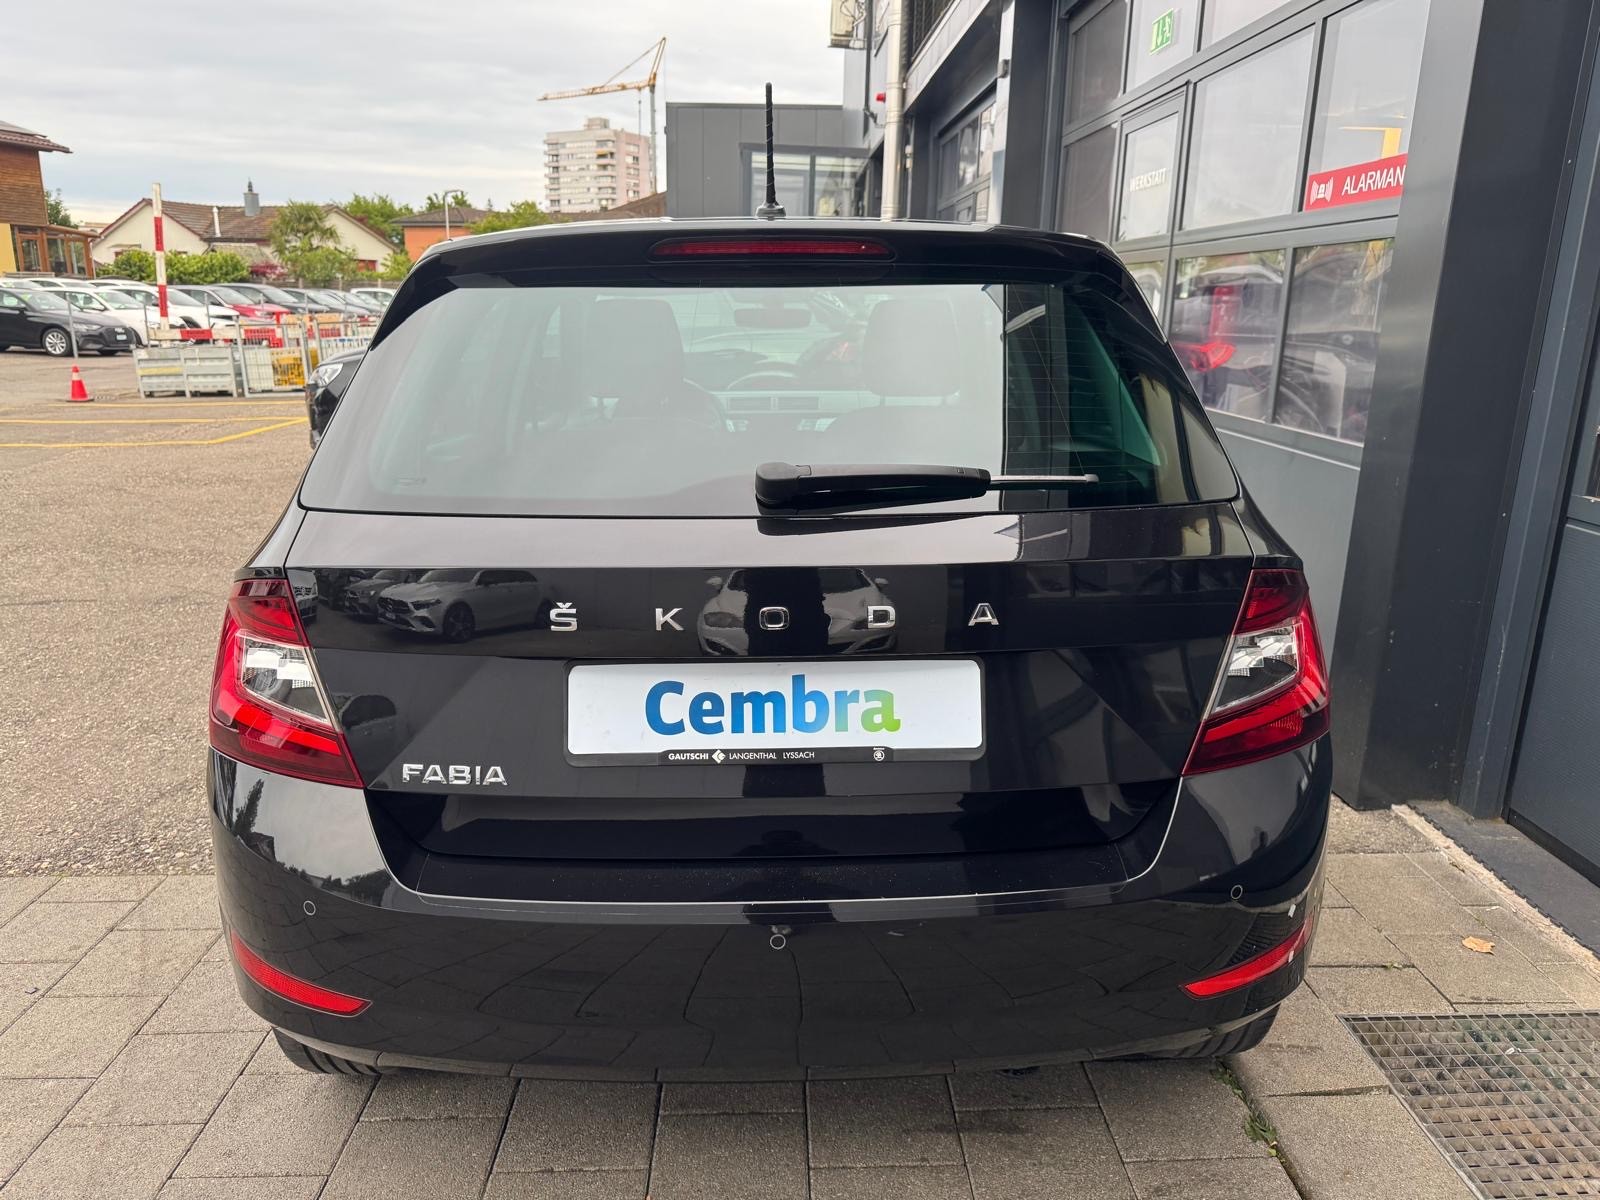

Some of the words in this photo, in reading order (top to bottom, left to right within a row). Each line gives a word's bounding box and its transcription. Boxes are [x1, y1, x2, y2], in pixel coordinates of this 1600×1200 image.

[1341, 164, 1407, 196] ALARMAN
[644, 673, 901, 736] Cembra
[667, 752, 709, 761] GAUTSCHI
[728, 751, 777, 760] LANGENTHAL
[782, 751, 815, 759] LYSSACH
[402, 763, 508, 786] FABIA
